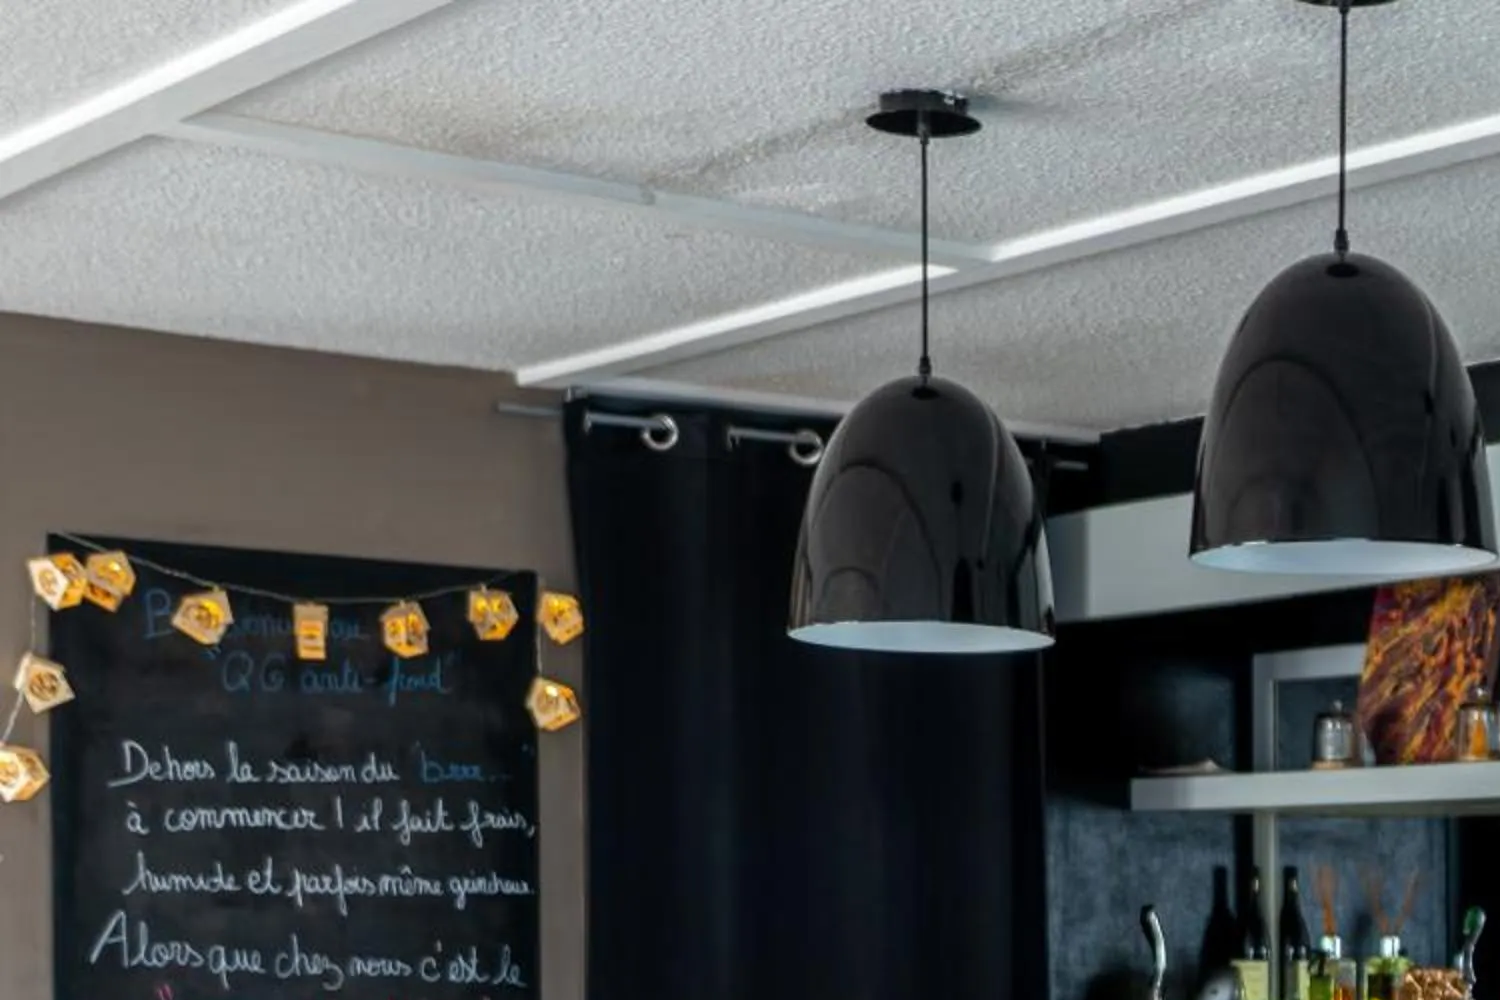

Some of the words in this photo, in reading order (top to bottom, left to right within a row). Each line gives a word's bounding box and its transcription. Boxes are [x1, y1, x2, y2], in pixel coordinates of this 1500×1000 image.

[108, 740, 216, 787] Dehors
[225, 742, 260, 783] la
[266, 752, 358, 784] saison
[360, 751, 401, 783] du
[126, 802, 150, 835] à
[165, 803, 327, 833] commencer
[354, 797, 384, 835] il
[392, 797, 456, 846] fait
[122, 850, 238, 896] humide
[246, 857, 286, 897] et
[285, 862, 382, 917] parfois
[379, 864, 445, 897] même
[89, 910, 206, 967] Alors
[207, 941, 264, 993] que
[274, 933, 345, 992] chez
[348, 952, 415, 980] nous
[420, 941, 492, 985] c'est
[494, 941, 529, 990] le
